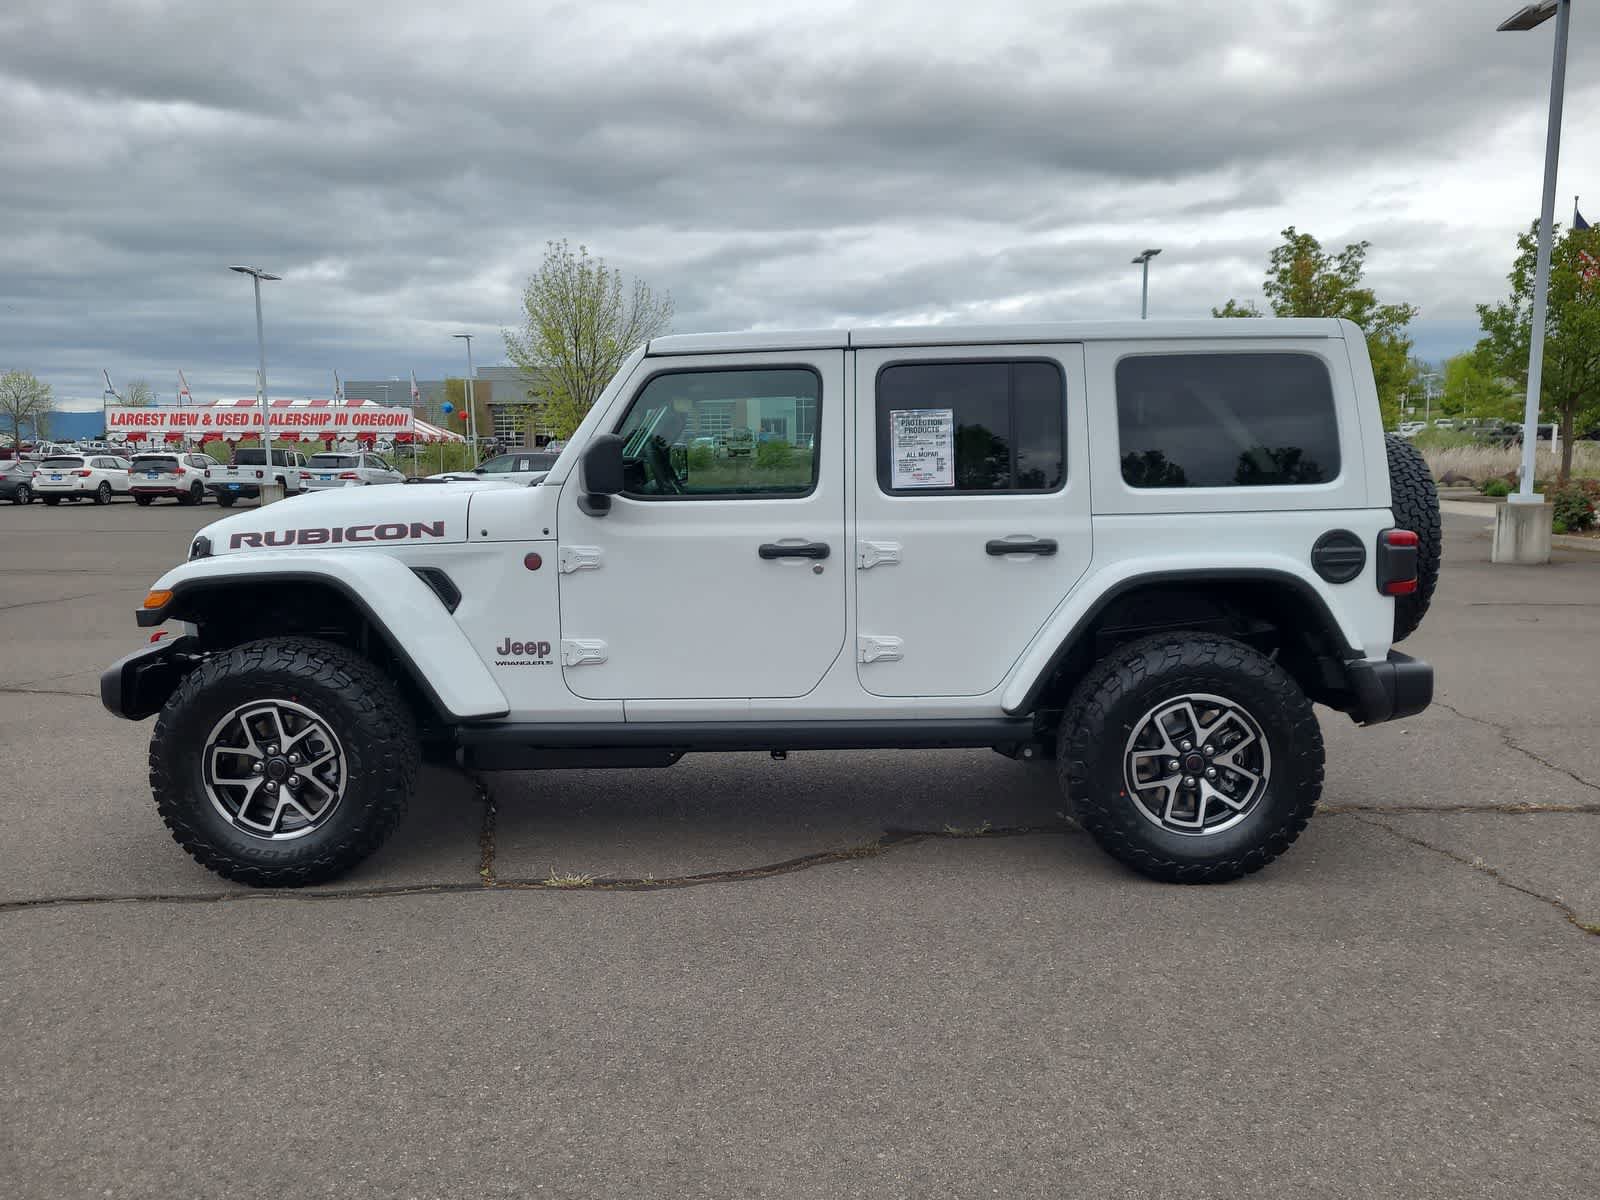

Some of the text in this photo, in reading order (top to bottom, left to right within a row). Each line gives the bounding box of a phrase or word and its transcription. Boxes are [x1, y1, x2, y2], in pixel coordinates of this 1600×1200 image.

[110, 413, 166, 425] LARGEST
[169, 413, 199, 425] NEW
[202, 413, 212, 425] &
[215, 413, 249, 425] USED
[253, 413, 331, 425] DALERSHIP
[335, 413, 348, 425] IN
[230, 521, 445, 549] RUBICON
[496, 637, 551, 658] Jeep
